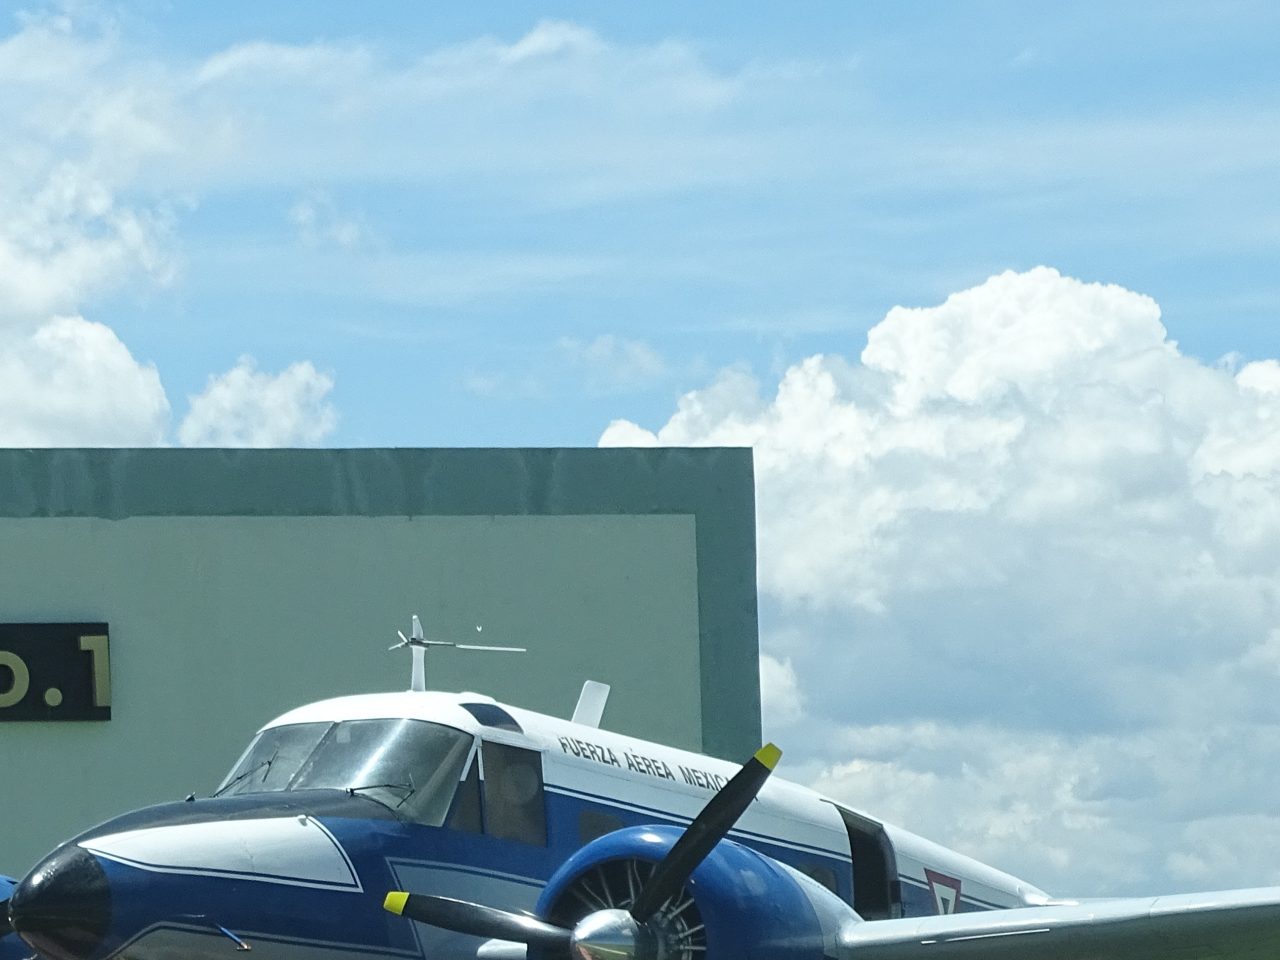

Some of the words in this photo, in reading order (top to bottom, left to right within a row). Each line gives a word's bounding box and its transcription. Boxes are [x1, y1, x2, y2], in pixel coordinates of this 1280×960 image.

[558, 736, 621, 768] FUERZA
[623, 748, 676, 781] AÉREA
[678, 764, 730, 791] MEXIC
